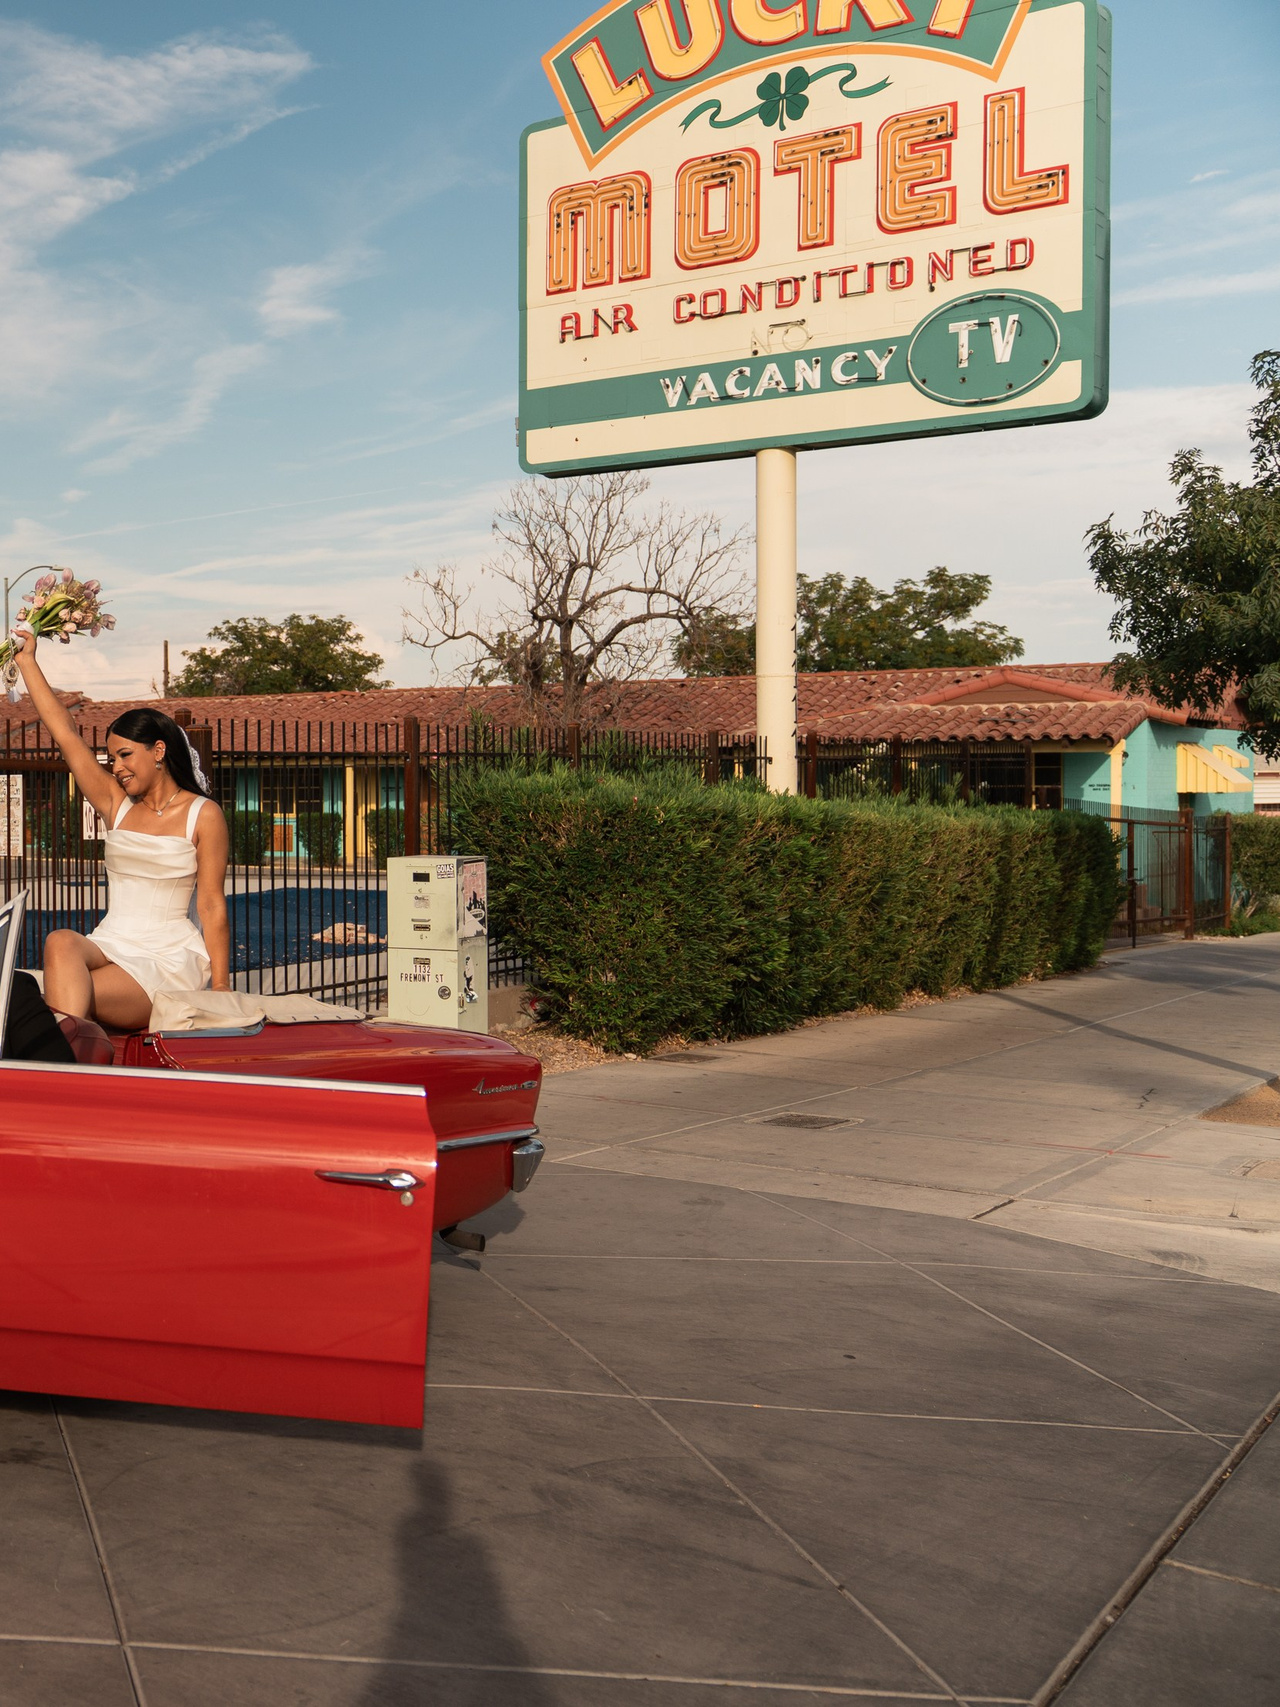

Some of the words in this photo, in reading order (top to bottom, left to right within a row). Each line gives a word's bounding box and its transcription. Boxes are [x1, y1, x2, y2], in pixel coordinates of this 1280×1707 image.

[546, 87, 1069, 296] MOTEL
[559, 304, 638, 343] AIR
[673, 237, 1035, 323] CONDITIONED
[948, 313, 1021, 369] TV
[660, 346, 898, 408] VACANCY
[400, 973, 431, 983] FREMONT
[435, 974, 444, 983] ST
[414, 965, 431, 974] 1132
